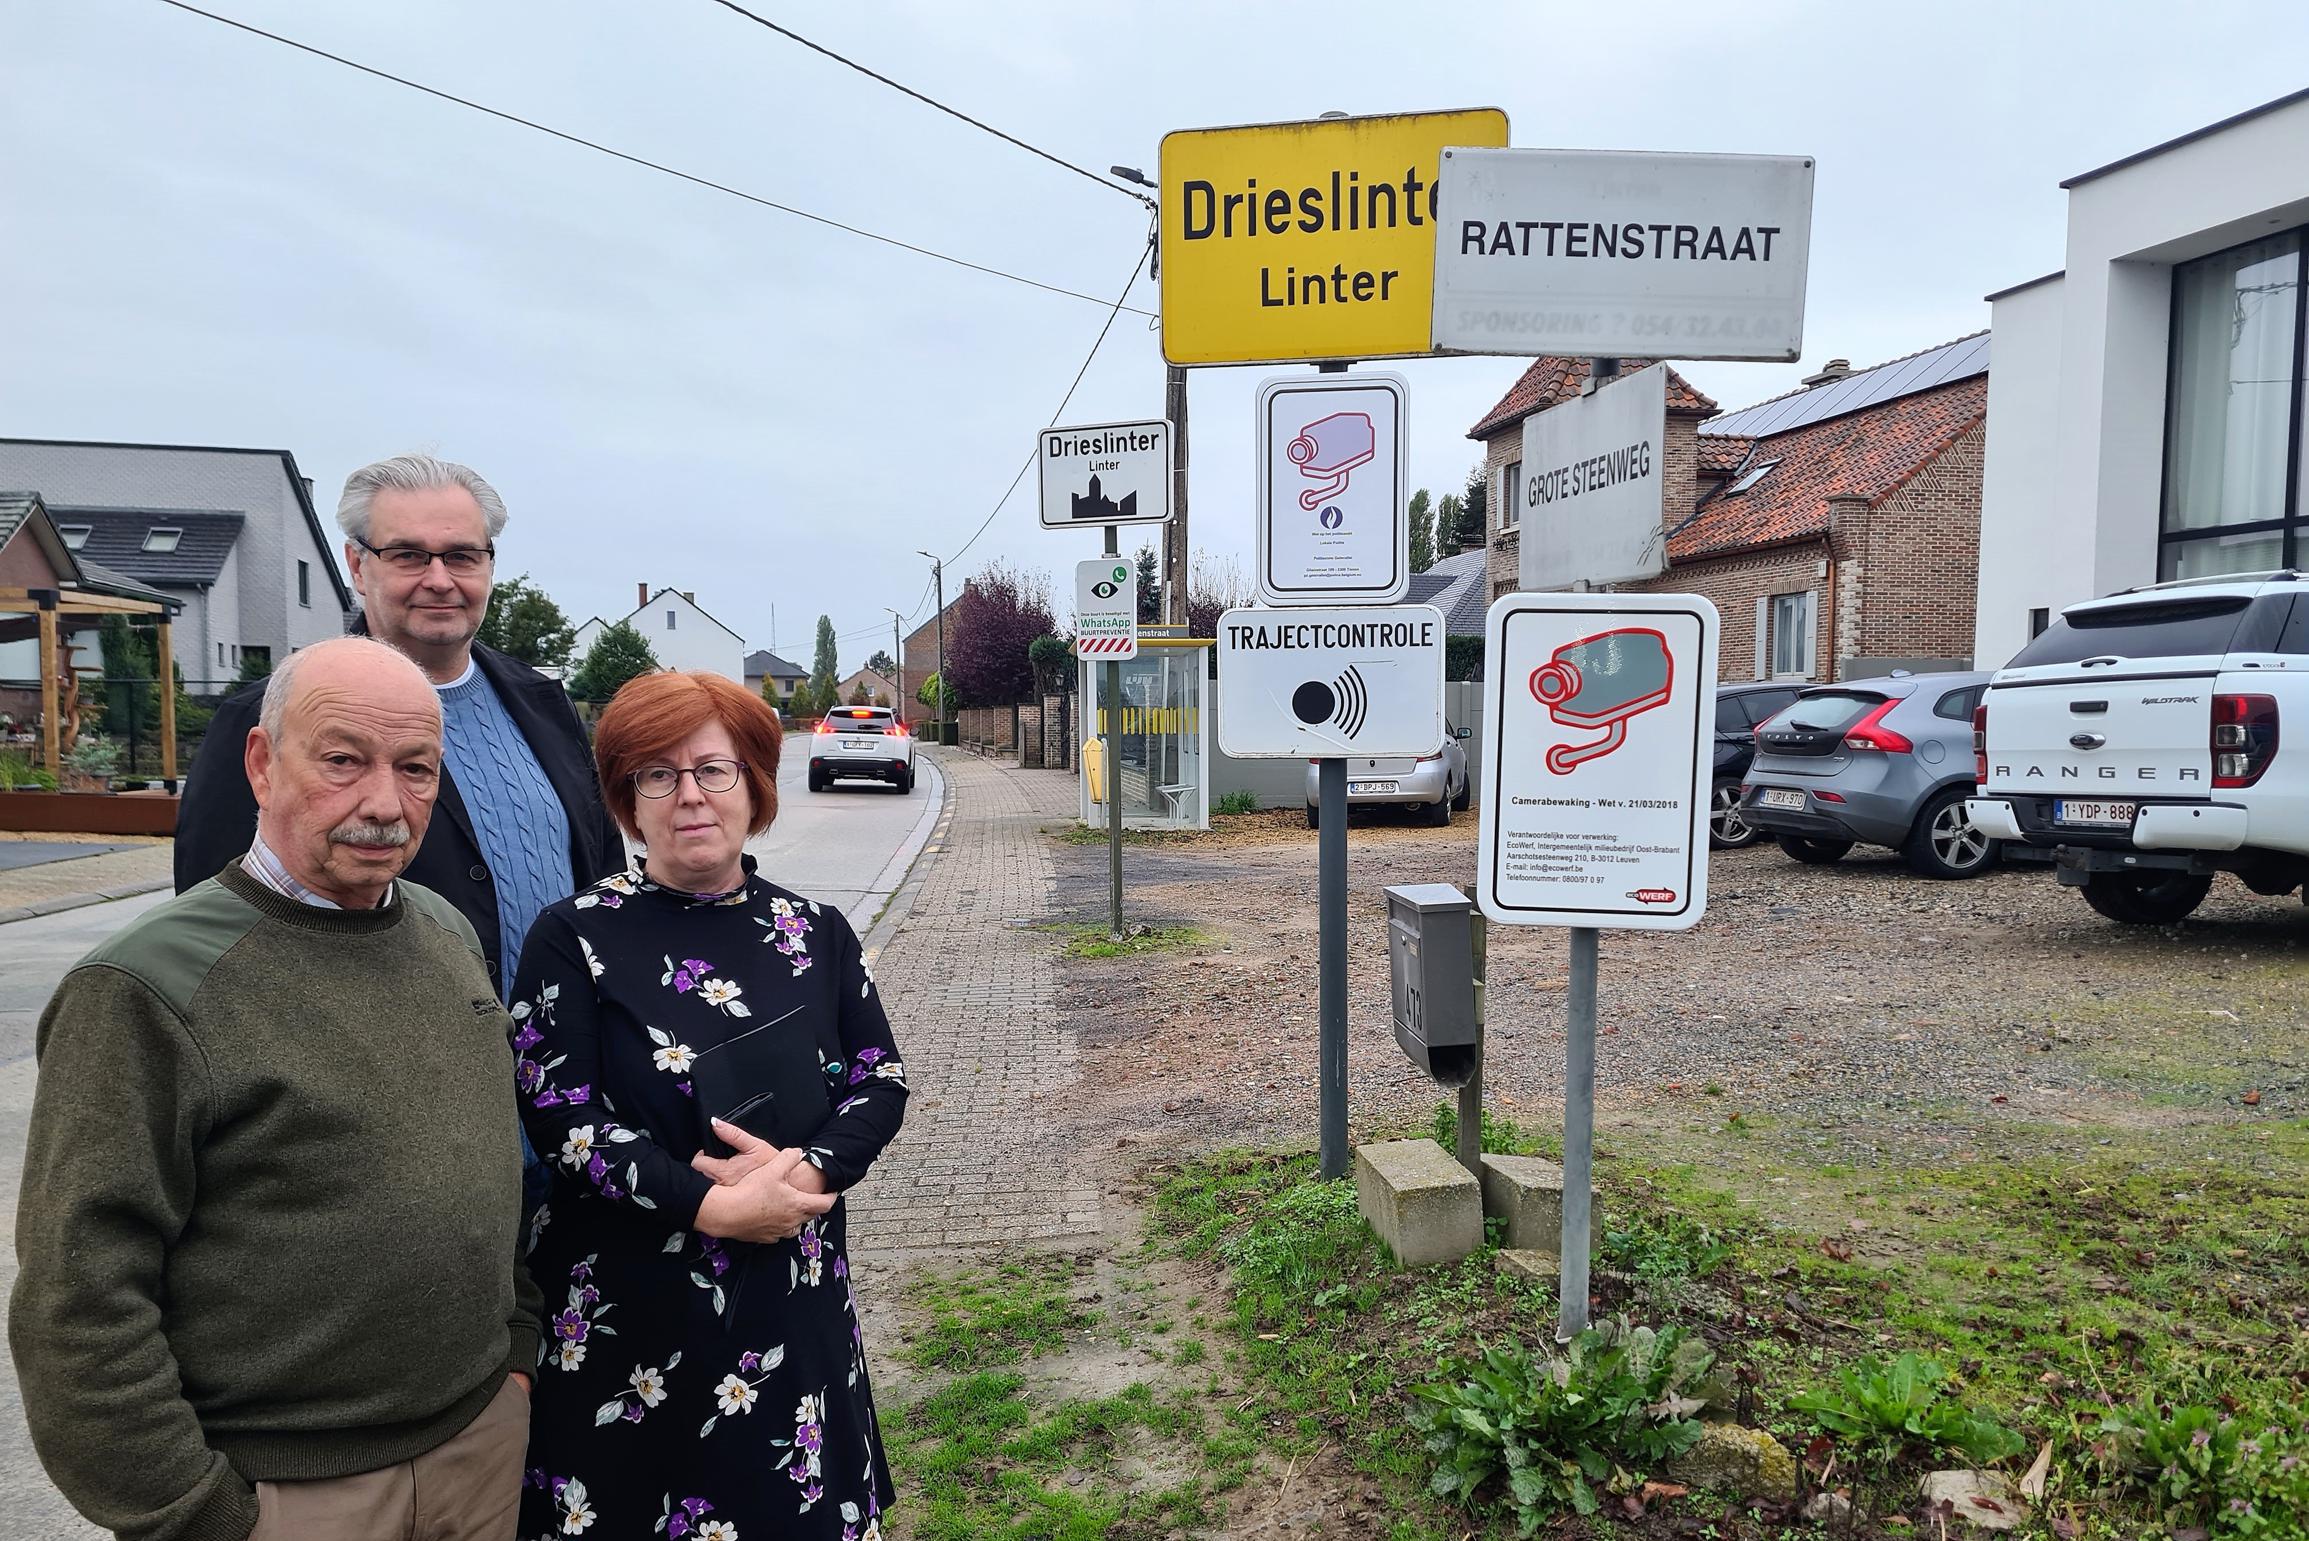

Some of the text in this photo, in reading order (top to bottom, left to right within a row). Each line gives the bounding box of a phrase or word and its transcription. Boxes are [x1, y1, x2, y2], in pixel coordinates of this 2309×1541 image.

[1461, 220, 1780, 261] RATTENSTRAAT
[1261, 264, 1399, 307] Linter
[1456, 309, 1604, 336] SPONSORING
[1049, 430, 1159, 458] Drieslinter
[1089, 460, 1120, 472] Linter
[1528, 440, 1650, 508] GROTE STEENWEG
[1080, 617, 1131, 629] WhatsApp
[1228, 623, 1434, 650] TRAJECTCONTROLE
[2141, 696, 2200, 705] WILDTRAK
[1996, 765, 2200, 781] RANGER
[1511, 796, 1590, 809] Camerabewaking
[1599, 798, 1616, 808] Wet
[1618, 800, 1627, 808] v.
[1629, 799, 1679, 809] 21/03/2018
[2064, 803, 2134, 820] 1-YDP-888
[1507, 830, 1564, 841] Verantwoordelijke
[1582, 833, 1619, 843] verwerking:
[1507, 841, 1536, 850] EcoWerf,
[1537, 842, 1593, 853] Intergemeentelijk
[1507, 852, 1573, 863] Aarschotsesteenweg
[1591, 855, 1615, 864] B-3012
[1616, 855, 1640, 864] Leuven
[1505, 863, 1583, 873] E-mail: info@ecowerf.be
[1506, 873, 1561, 883] Telefoonnummer:
[1597, 876, 1605, 885] 97
[1406, 983, 1422, 1031] 473
